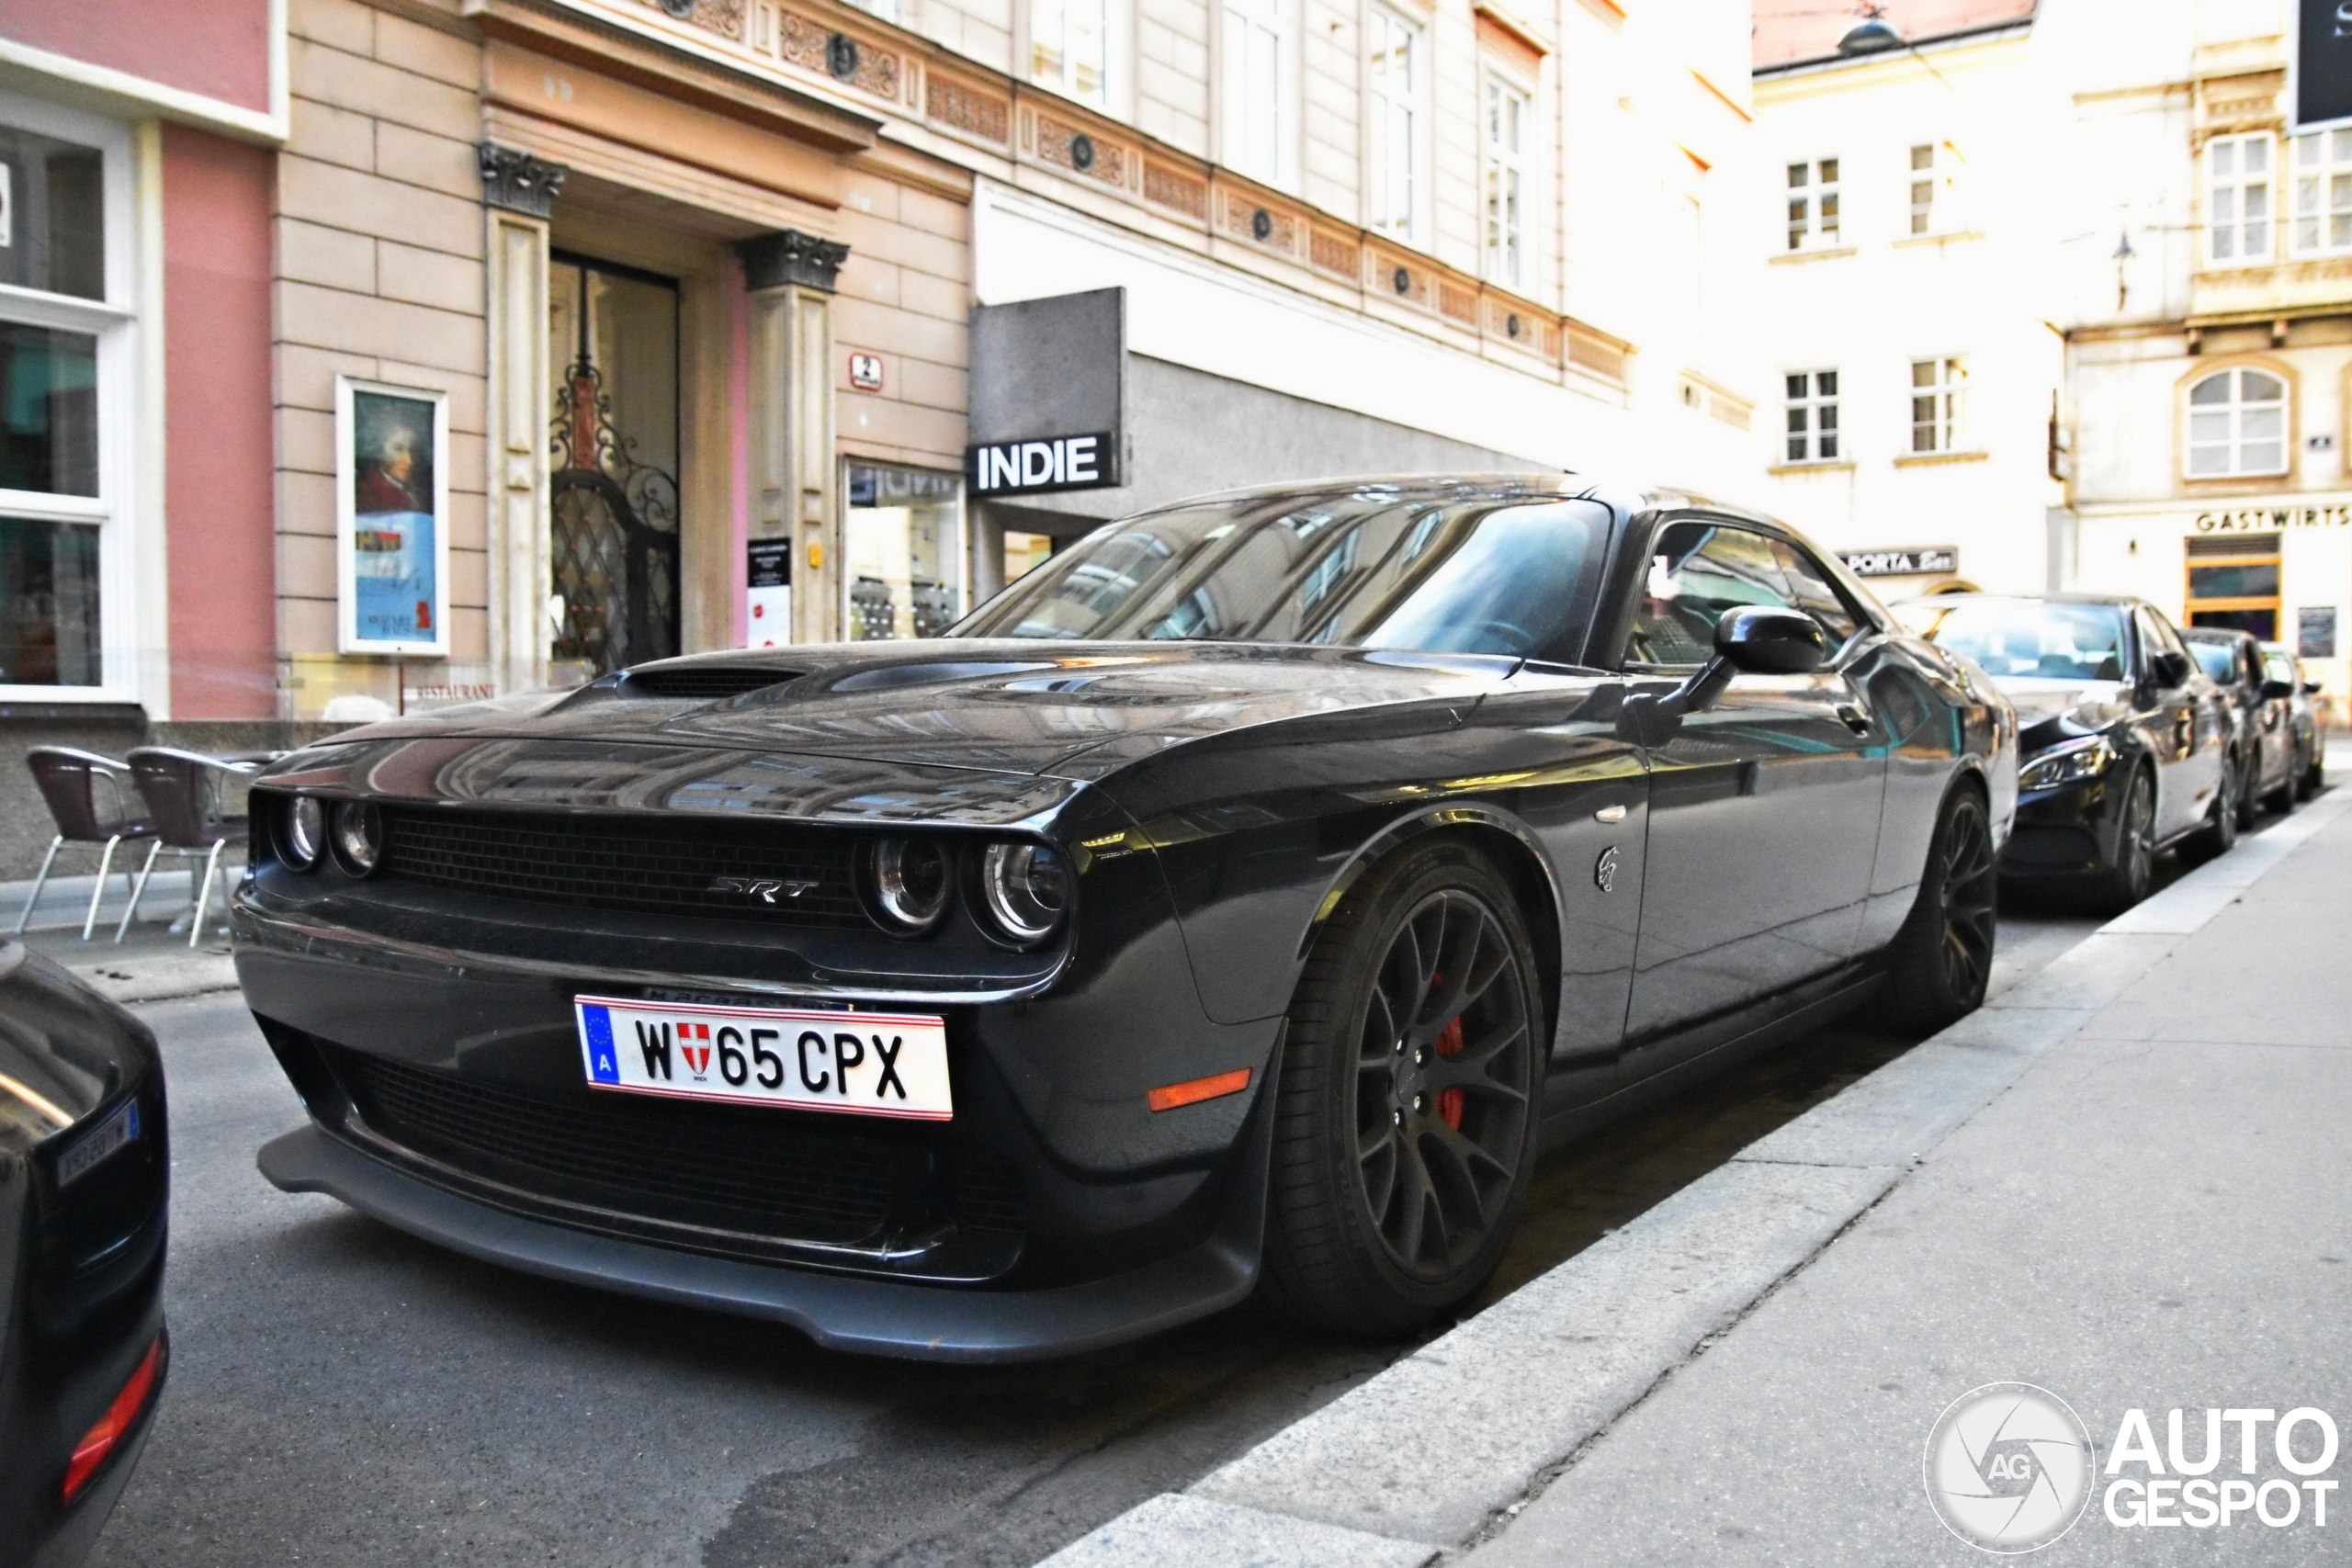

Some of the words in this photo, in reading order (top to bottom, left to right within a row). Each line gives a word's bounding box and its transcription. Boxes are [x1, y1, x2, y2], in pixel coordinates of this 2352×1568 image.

[863, 355, 872, 377] 2
[978, 436, 1099, 490] INDIE
[2197, 506, 2350, 531] GASTWIRTS
[1848, 552, 1913, 572] PORTA
[417, 684, 495, 700] RESTAURANT
[707, 876, 820, 903] SRT
[598, 1054, 612, 1072] A
[635, 1020, 673, 1080] W
[716, 1028, 785, 1089] 65
[797, 1030, 909, 1100] CPX
